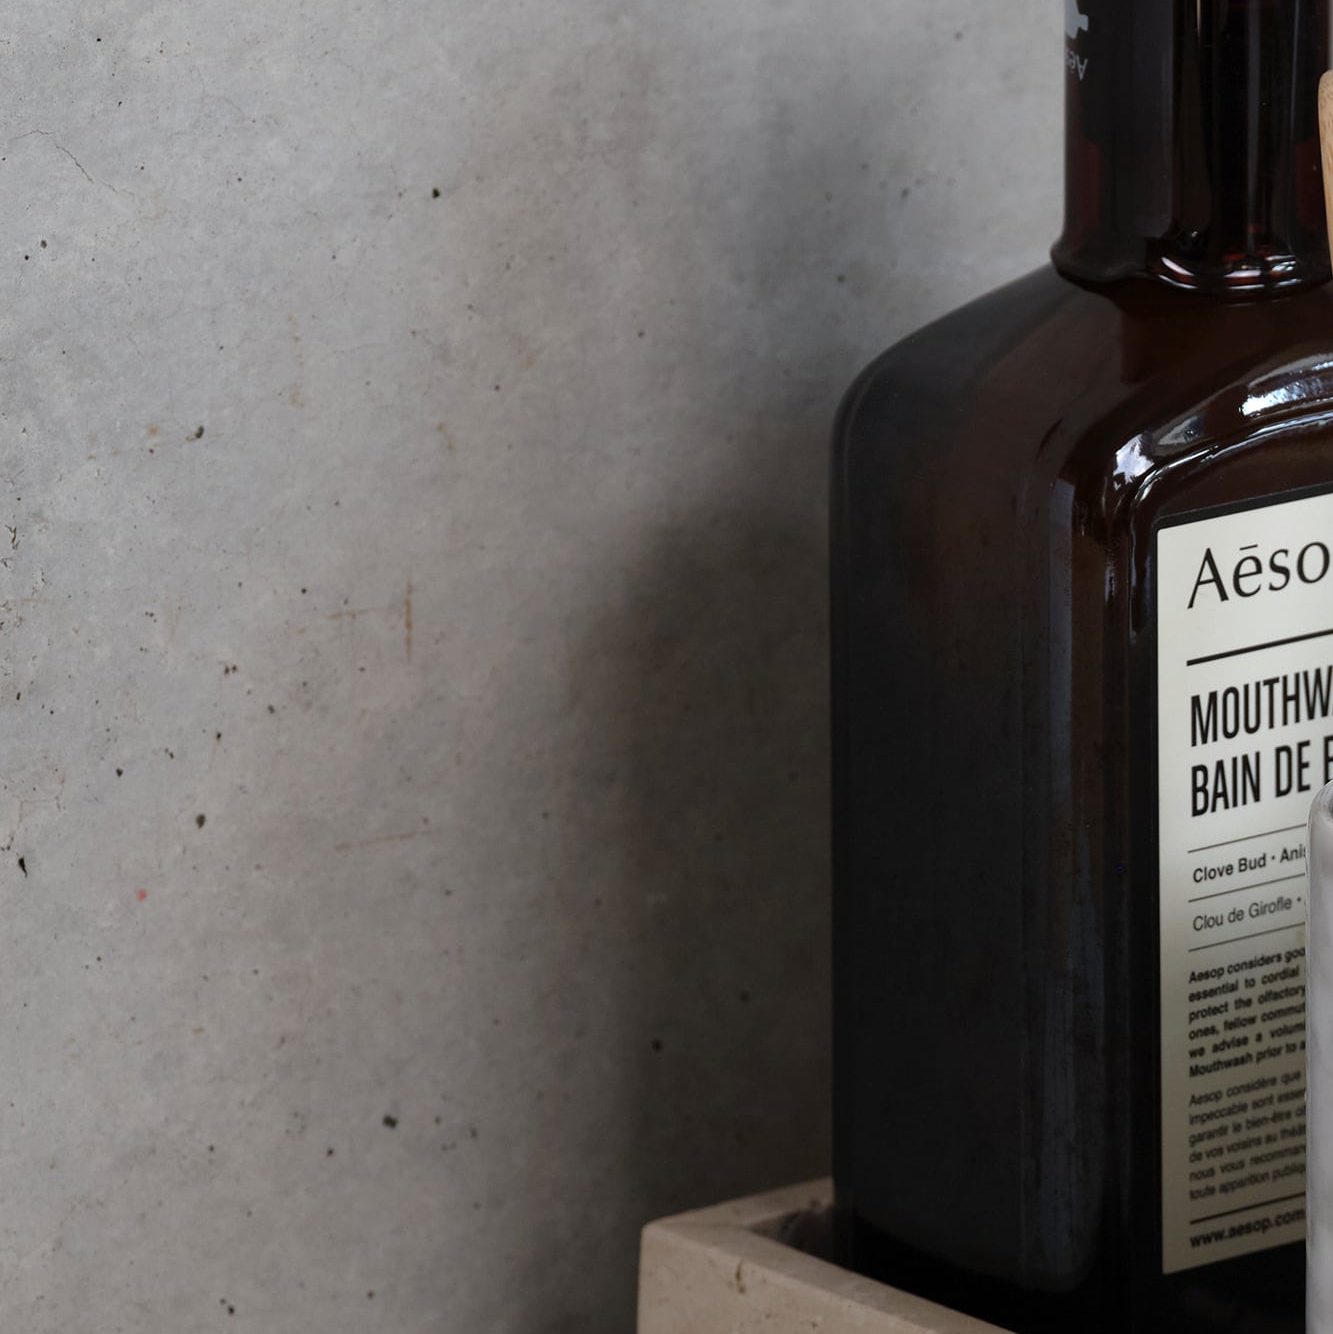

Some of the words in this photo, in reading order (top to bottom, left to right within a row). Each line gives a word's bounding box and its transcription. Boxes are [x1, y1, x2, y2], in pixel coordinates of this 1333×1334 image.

[1191, 751, 1261, 817] BAIN
[1275, 740, 1311, 798] DE
[1193, 863, 1234, 883] Clove
[1238, 852, 1267, 873] Bud
[1193, 913, 1223, 931] Clou
[1228, 908, 1245, 923] de
[1249, 896, 1292, 918] Girofle
[1188, 967, 1225, 984] Aesop
[1227, 954, 1282, 974] considers
[1188, 979, 1239, 1002] essential
[1244, 977, 1256, 989] to
[1261, 965, 1299, 985] cordial
[1188, 1001, 1228, 1025] protect
[1234, 998, 1252, 1010] the
[1224, 1015, 1258, 1031] fellow
[1188, 1047, 1205, 1058] we
[1212, 1036, 1248, 1053] advise
[1255, 1032, 1263, 1042] a
[1188, 1052, 1253, 1077] Mouthwash
[1256, 1046, 1282, 1064] prior
[1285, 1042, 1297, 1054] to
[1188, 1090, 1223, 1107] Aesop
[1188, 1102, 1248, 1126] impeccable
[1252, 1094, 1274, 1110] sont
[1188, 1209, 1306, 1248] www.aesop.com
